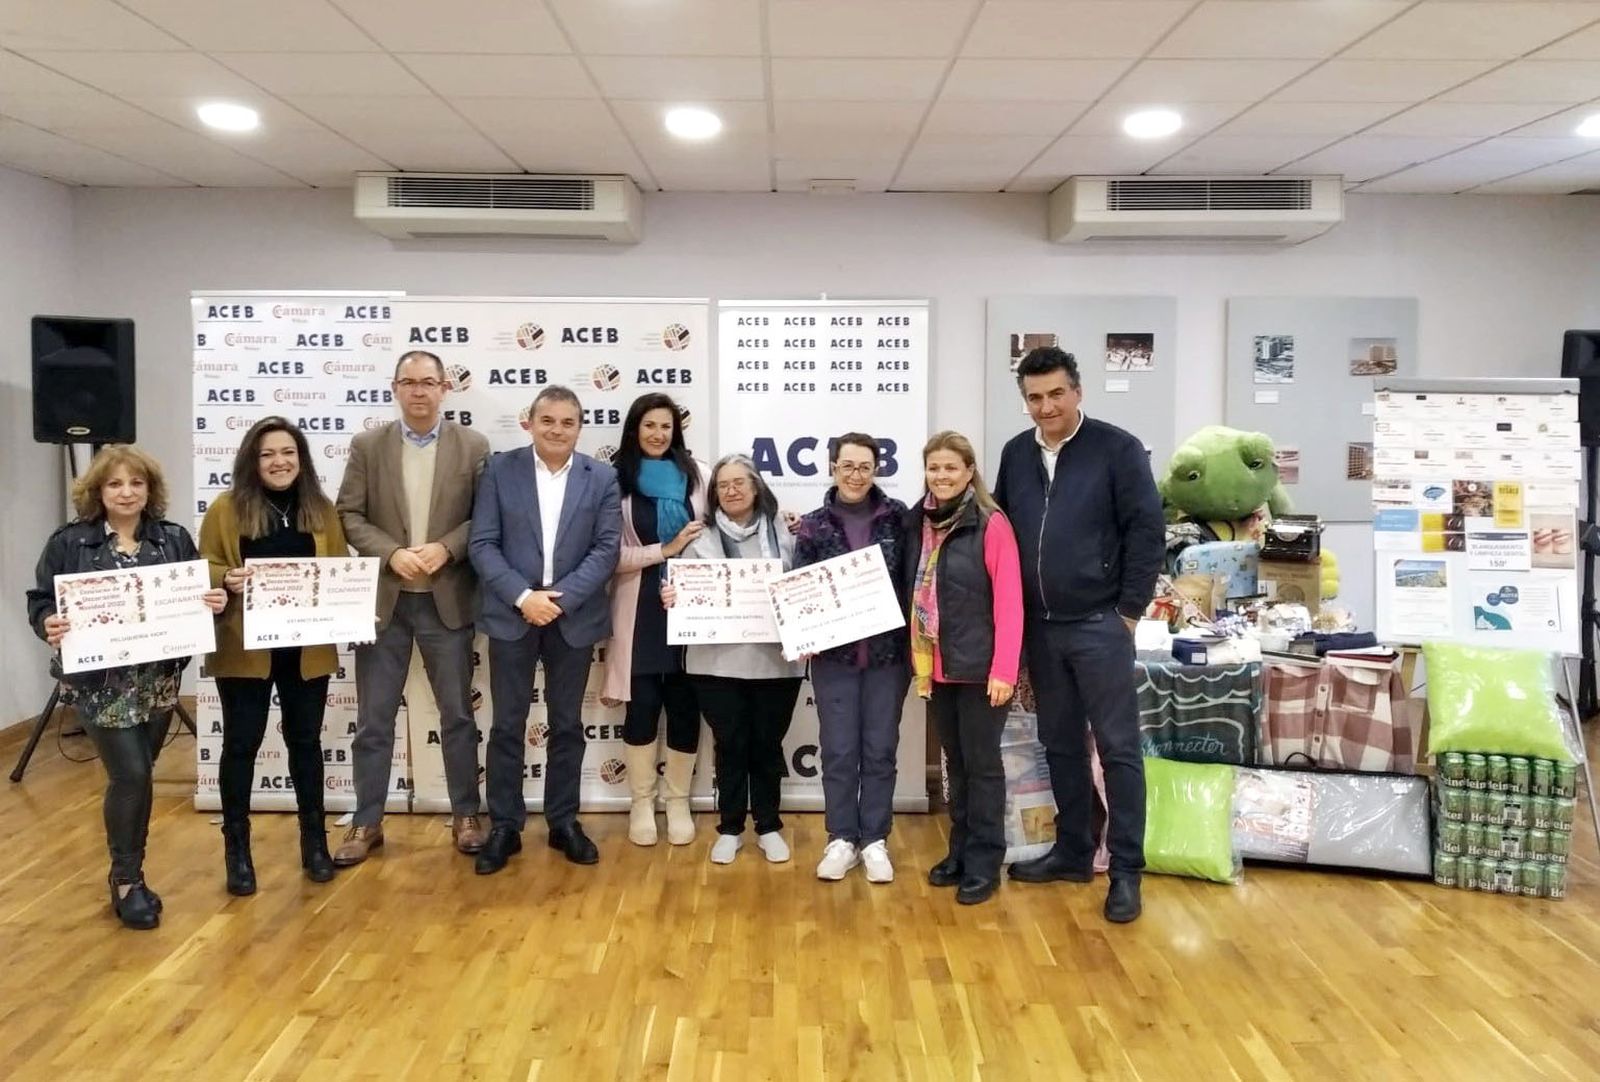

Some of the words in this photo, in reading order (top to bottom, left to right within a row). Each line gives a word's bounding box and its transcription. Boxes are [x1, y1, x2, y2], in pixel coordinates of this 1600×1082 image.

[207, 305, 254, 319] ACEB
[344, 305, 391, 319] ACEB
[737, 317, 769, 326] ACEB
[784, 317, 816, 326] ACEB
[830, 317, 863, 326] ACEB
[877, 317, 910, 326] ACEB
[296, 334, 344, 347] ACEB
[409, 326, 469, 343] ACEB
[561, 327, 619, 344] ACEB
[737, 339, 769, 348] ACEB
[784, 339, 816, 348] ACEB
[830, 339, 863, 348] ACEB
[877, 339, 910, 348] ACEB
[257, 361, 304, 375] ACEB
[737, 361, 769, 370] ACEB
[784, 361, 816, 370] ACEB
[830, 361, 863, 370] ACEB
[877, 361, 910, 370] ACEB
[488, 368, 548, 385] ACEB
[636, 368, 692, 384] ACEB
[737, 383, 769, 392] ACEB
[784, 383, 816, 392] ACEB
[830, 383, 863, 392] ACEB
[877, 383, 910, 392] ACEB
[207, 388, 256, 402] ACEB
[345, 389, 392, 403] ACEB
[582, 409, 620, 425] CEB
[78, 655, 104, 664] ACEB
[260, 776, 295, 789] ACE
